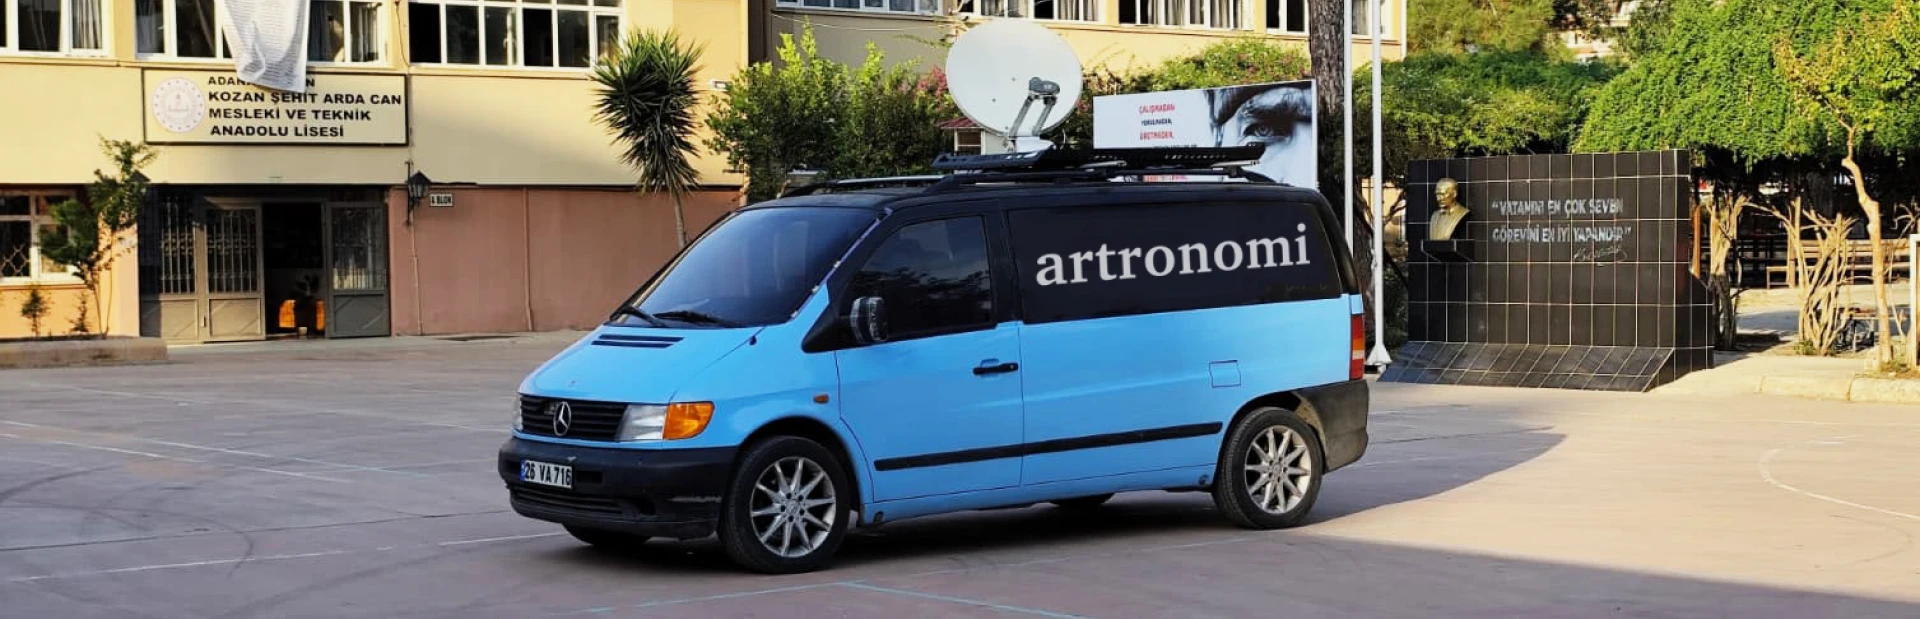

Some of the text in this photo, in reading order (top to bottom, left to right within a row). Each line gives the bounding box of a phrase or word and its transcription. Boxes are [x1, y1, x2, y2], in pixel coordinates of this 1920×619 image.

[208, 76, 252, 86] ADAN
[208, 91, 265, 103] KOZAN
[323, 93, 365, 105] ARDA
[370, 94, 401, 105] CAN
[208, 107, 372, 121] MESLEKİ VE TEKNİK
[210, 124, 344, 137] ANADOLU LİSESİ
[1547, 199, 1561, 215] EN
[1564, 198, 1586, 219] ÇOK
[1589, 197, 1624, 214] SEVEN
[1541, 227, 1555, 243] EN
[1557, 223, 1571, 243] İYİ
[1036, 222, 1310, 286] artronomi
[525, 461, 571, 486] 26 VA 716
